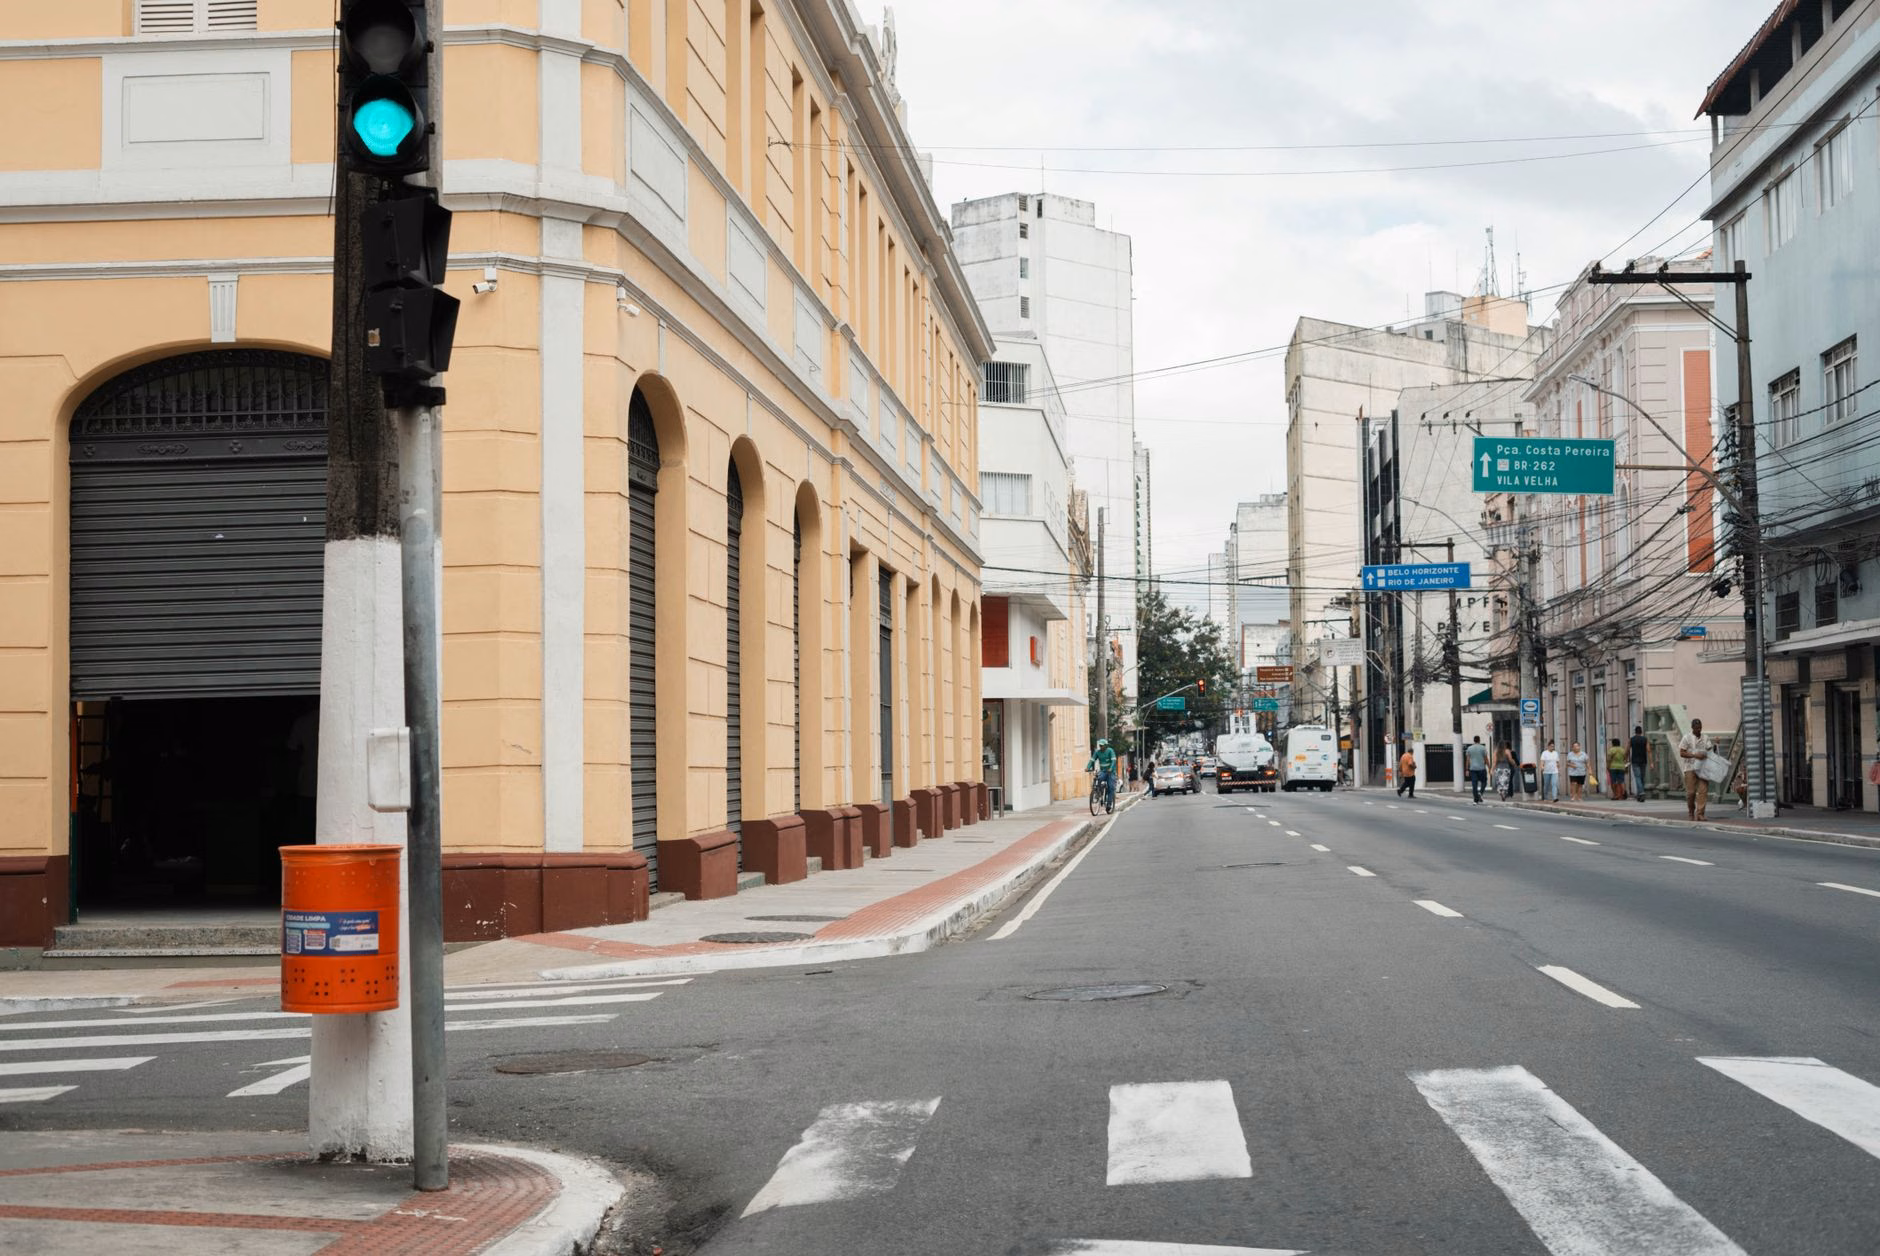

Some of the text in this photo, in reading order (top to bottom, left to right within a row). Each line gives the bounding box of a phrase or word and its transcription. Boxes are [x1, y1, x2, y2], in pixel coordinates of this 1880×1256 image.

[1526, 445, 1561, 456] Costa
[1565, 446, 1610, 457] Pereira
[1497, 476, 1558, 486] VILA VELHA
[1412, 567, 1460, 575] HORIZONTE
[1418, 577, 1455, 585] JANEIRO
